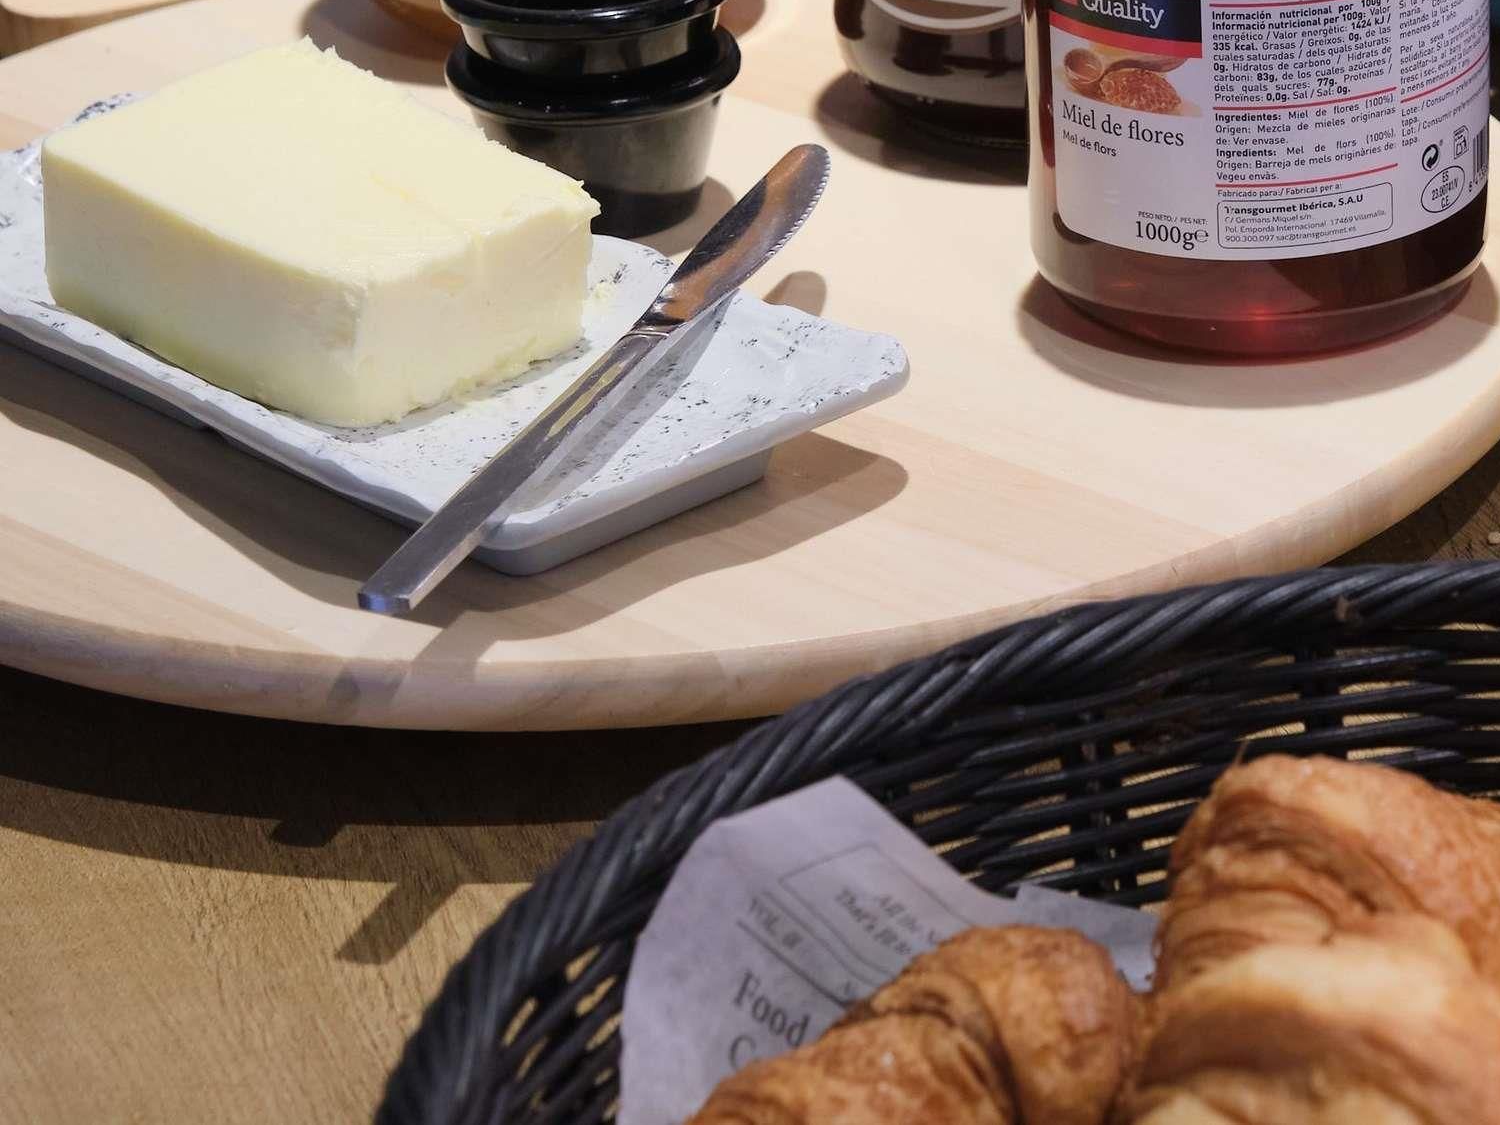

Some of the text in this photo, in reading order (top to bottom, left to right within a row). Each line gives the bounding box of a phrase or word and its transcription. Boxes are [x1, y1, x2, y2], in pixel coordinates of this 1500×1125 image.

[1212, 11, 1271, 20] Información
[1280, 8, 1332, 18] nutricional
[1339, 4, 1353, 14] por
[1212, 21, 1265, 31] Informació
[1269, 19, 1321, 29] nutricional
[1324, 17, 1339, 26] per
[1370, 5, 1390, 16] Valor
[1213, 32, 1263, 42] energético
[1273, 31, 1297, 40] Valor
[1352, 20, 1372, 30] 1424
[1375, 17, 1385, 25] kJ
[1213, 42, 1230, 51] 335
[1235, 41, 1258, 51] kcal.
[1262, 41, 1296, 50] Grasas
[1366, 29, 1375, 38] de
[1379, 25, 1391, 34] las
[1062, 100, 1184, 146] Miel de flores
[1215, 113, 1281, 123] Ingredientes:
[1289, 110, 1308, 119] Miel
[1316, 108, 1327, 117] de
[1334, 104, 1359, 115] flores
[1062, 129, 1117, 157] Mel de flors
[1216, 148, 1276, 159] Ingredients:
[1287, 147, 1304, 155] Mel
[1315, 144, 1326, 152] de
[1336, 139, 1357, 149] flors
[1300, 199, 1336, 211] Ibérica,
[734, 971, 811, 1048] Food
